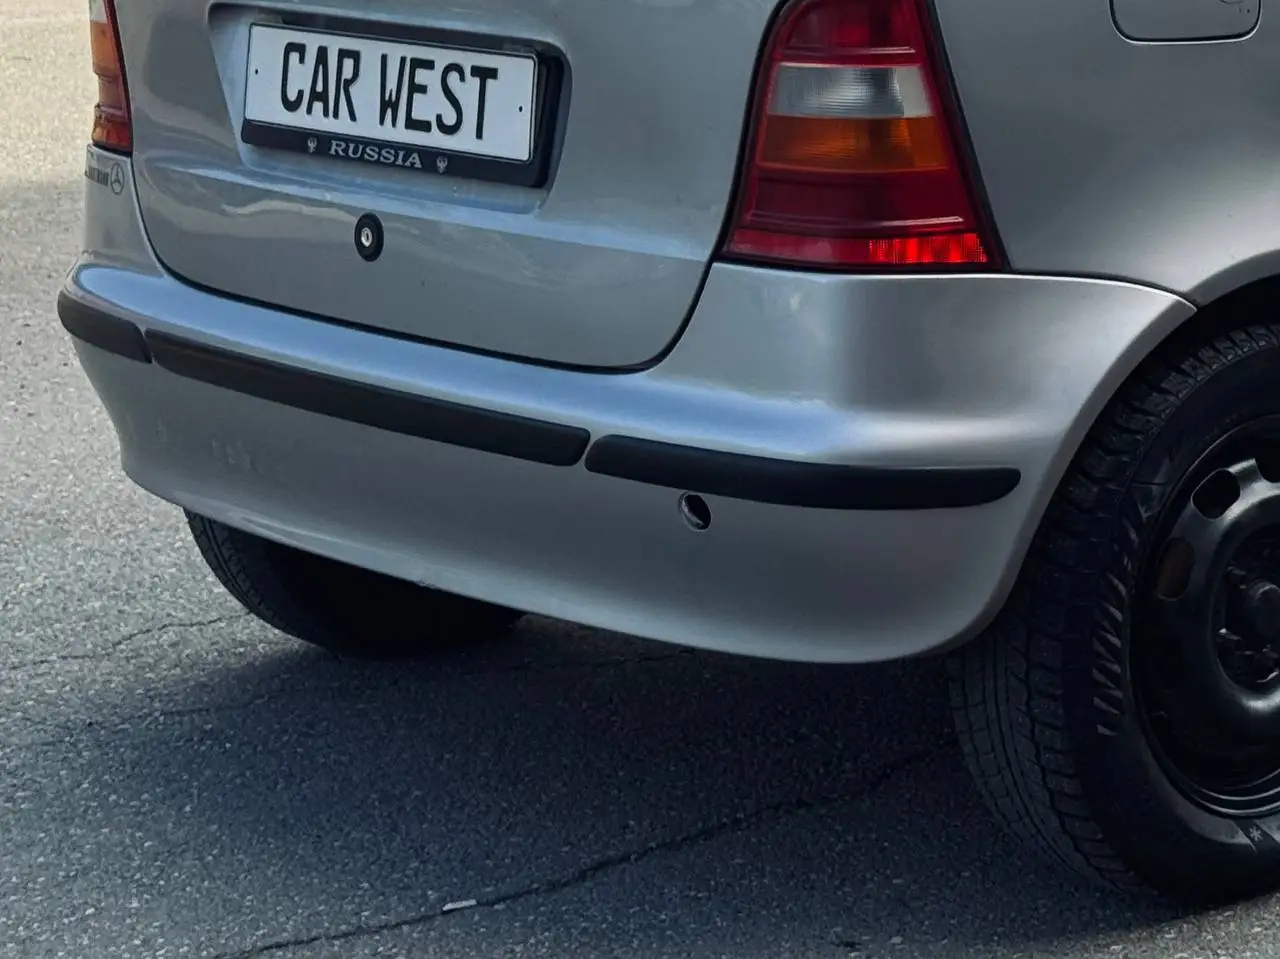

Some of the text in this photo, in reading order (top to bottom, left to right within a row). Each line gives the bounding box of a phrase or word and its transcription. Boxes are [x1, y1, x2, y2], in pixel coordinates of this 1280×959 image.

[280, 42, 498, 139] CAR WEST
[328, 140, 422, 169] RUSSIA
